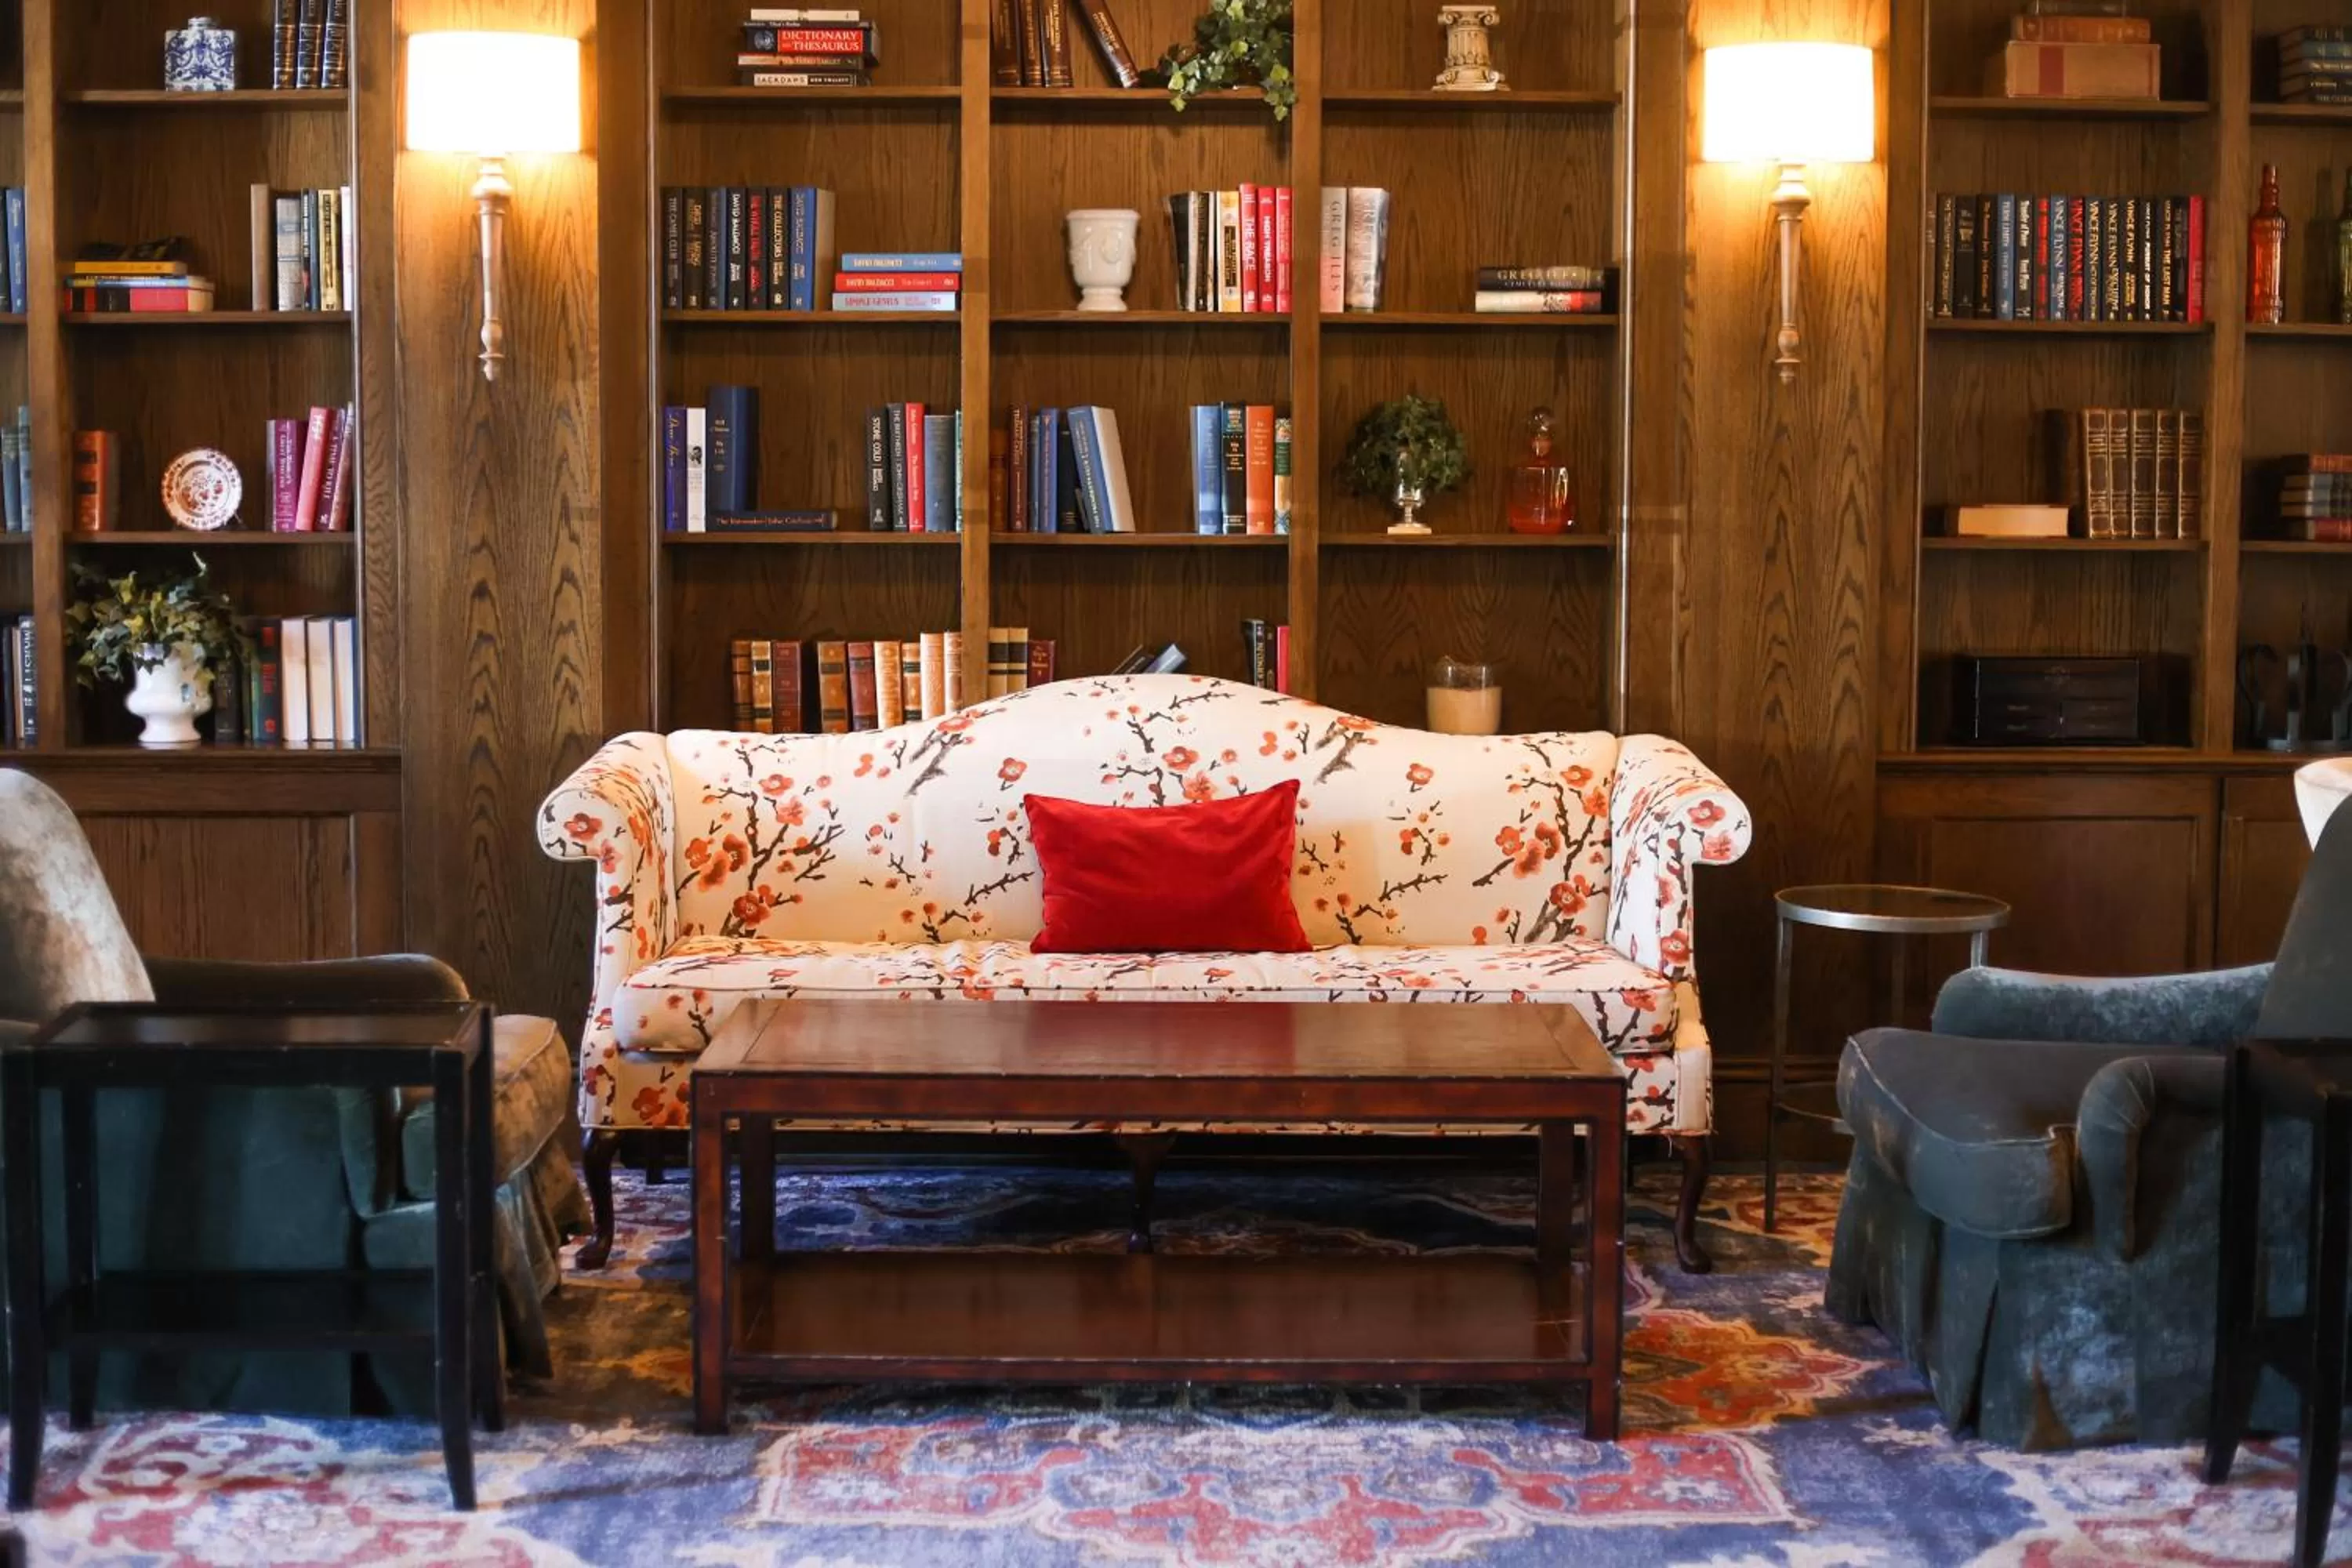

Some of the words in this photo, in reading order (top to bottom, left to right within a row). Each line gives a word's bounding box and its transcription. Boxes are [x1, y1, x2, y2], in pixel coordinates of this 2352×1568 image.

[782, 31, 857, 40] DICTIONARY
[793, 41, 860, 51] THESAURUS
[774, 194, 783, 210] THE
[2053, 200, 2064, 230] VINCE
[2070, 199, 2083, 234] VINCE
[2126, 200, 2135, 230] VINCE
[1246, 217, 1256, 238] THE
[1330, 201, 1342, 248] GREG
[2088, 201, 2099, 234] VINCE
[2107, 203, 2118, 233] VINCE
[773, 211, 783, 258] COLLECTORS
[2088, 234, 2099, 263] FLYNN
[2125, 231, 2135, 263] FLYNN
[1245, 241, 1256, 270] RACE
[2053, 233, 2065, 267] FLYNN
[2070, 238, 2083, 273] FLYNN
[2107, 234, 2118, 267] FLYNN
[2162, 249, 2171, 265] THE
[2144, 272, 2151, 283] OF
[2162, 267, 2171, 285] LAST
[2162, 287, 2171, 305] MAN
[872, 416, 882, 441] STONE
[893, 410, 902, 422] THE
[872, 442, 882, 462] COLD
[894, 423, 902, 456] BRETHREN
